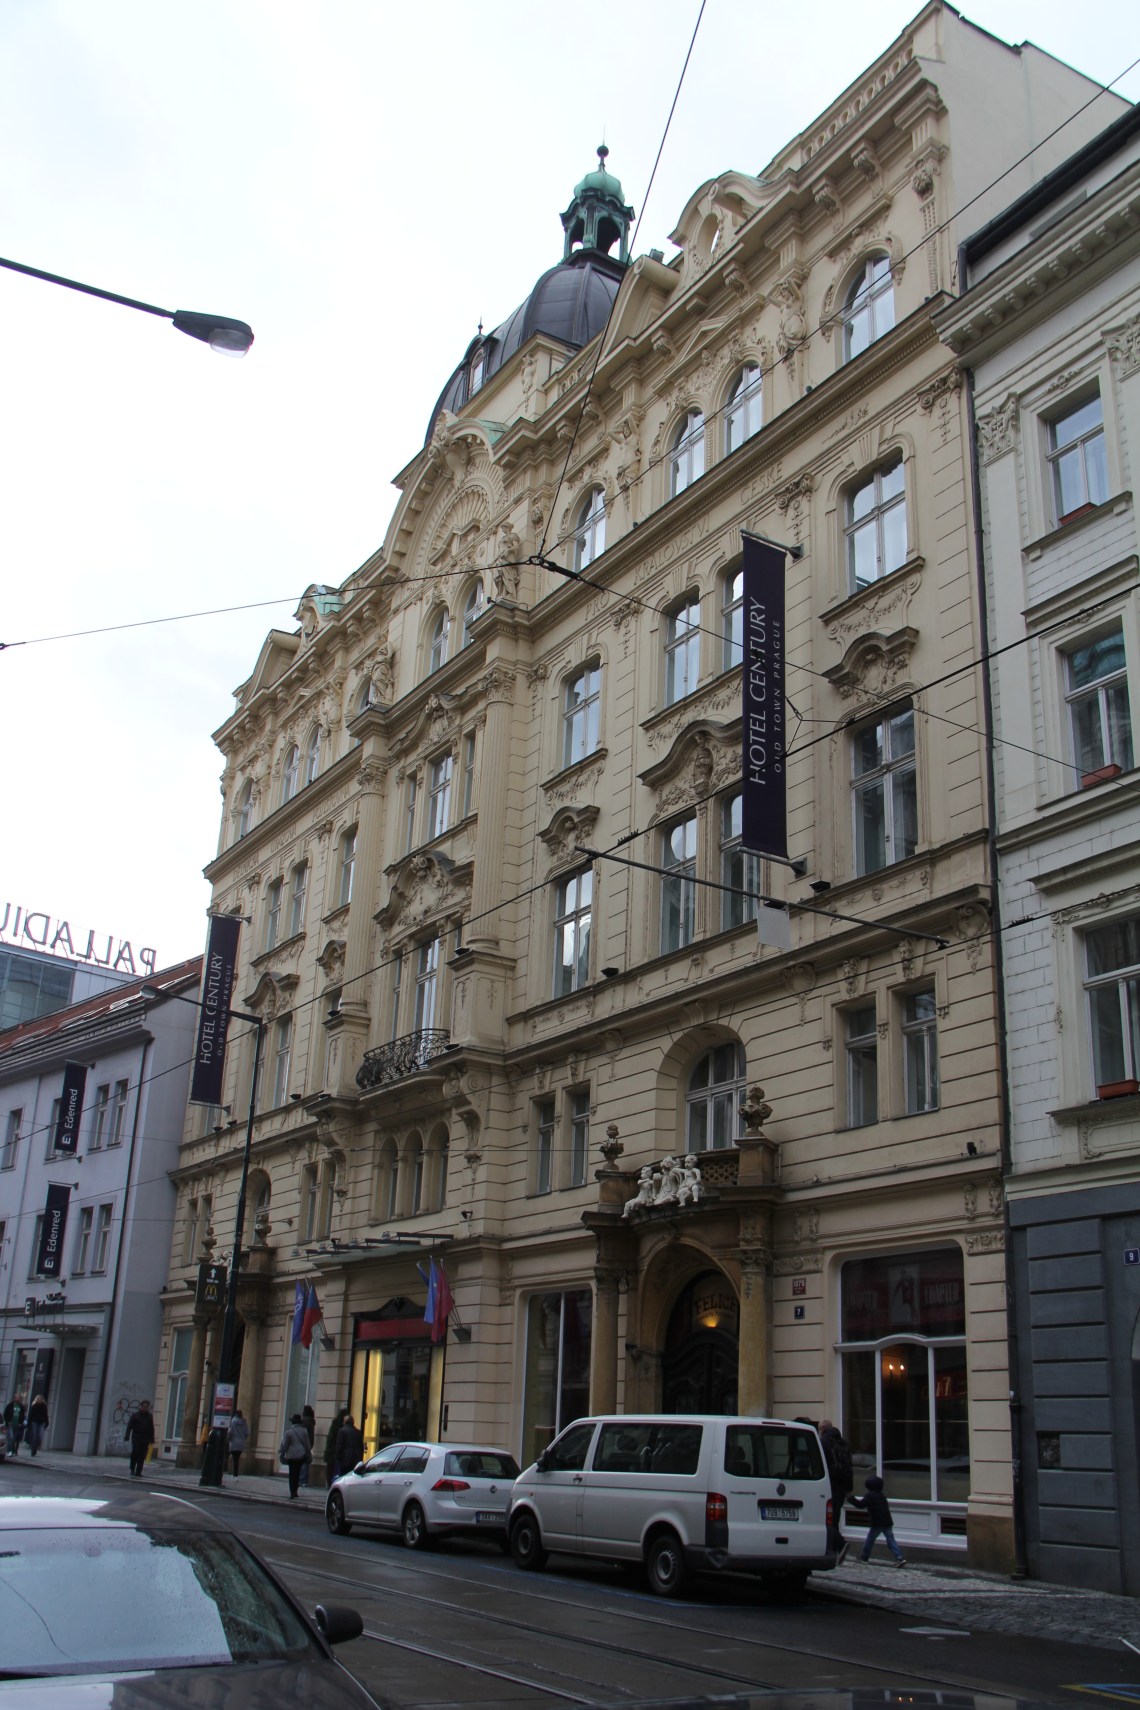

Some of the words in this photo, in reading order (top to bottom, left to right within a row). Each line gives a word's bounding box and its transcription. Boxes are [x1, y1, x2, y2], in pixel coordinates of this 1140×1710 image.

[749, 596, 766, 702] CENTURY
[772, 620, 781, 679] PRAGUE
[773, 688, 781, 732] TOWN
[749, 710, 766, 785] HOTEL
[205, 952, 223, 1016] CENTURY
[223, 965, 232, 1000] PRAGUE
[200, 1019, 216, 1064] HOTEL
[64, 1088, 78, 1129] Edenred
[47, 1210, 61, 1252] Edenred
[1128, 1252, 1134, 1261] 9
[796, 1308, 801, 1316] 7
